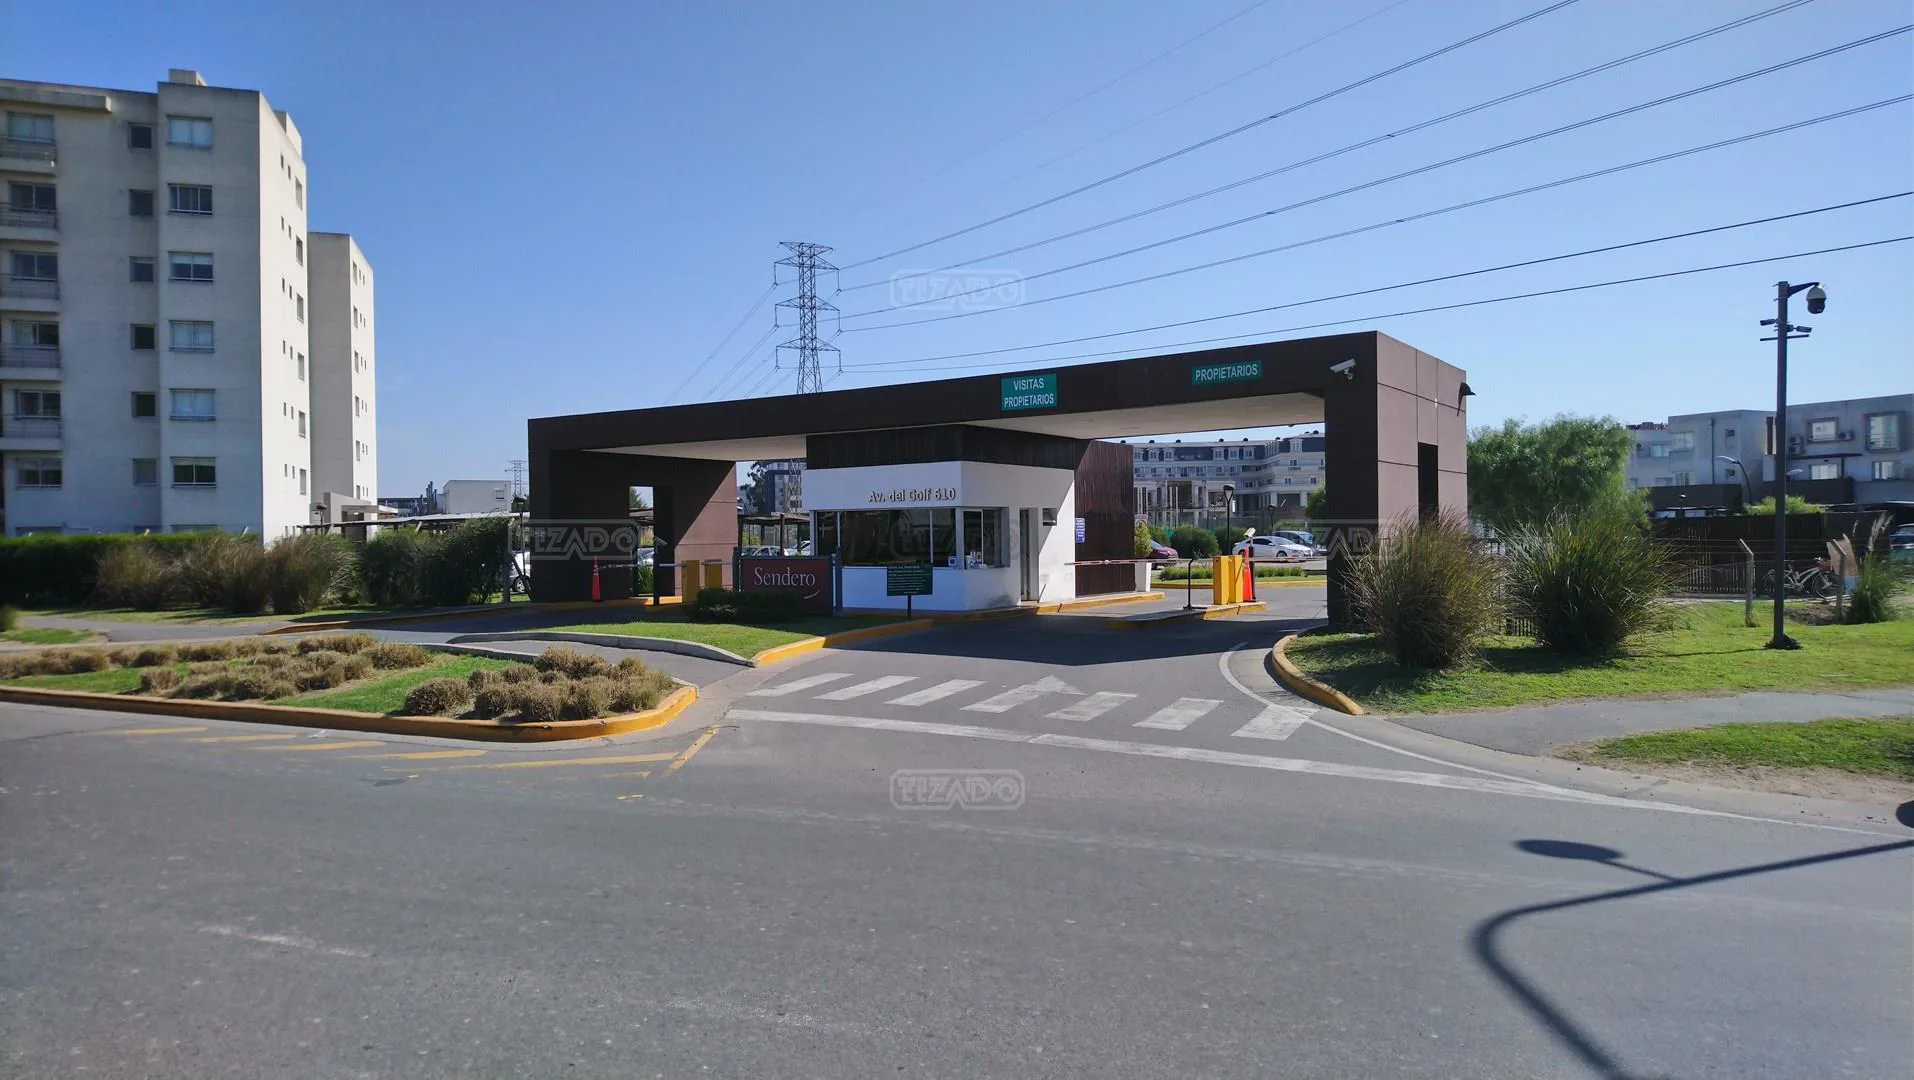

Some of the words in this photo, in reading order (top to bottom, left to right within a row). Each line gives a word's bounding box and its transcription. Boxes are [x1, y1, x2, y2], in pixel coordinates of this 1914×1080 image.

[1195, 363, 1258, 382] PROPIETARIOS
[1013, 377, 1045, 391] VISITAS
[1004, 393, 1054, 408] PROPIETARIOS
[868, 490, 886, 503] Av.
[888, 489, 906, 502] del
[909, 488, 932, 501] Golf
[934, 487, 956, 500] 610
[753, 566, 816, 586] Sendero
